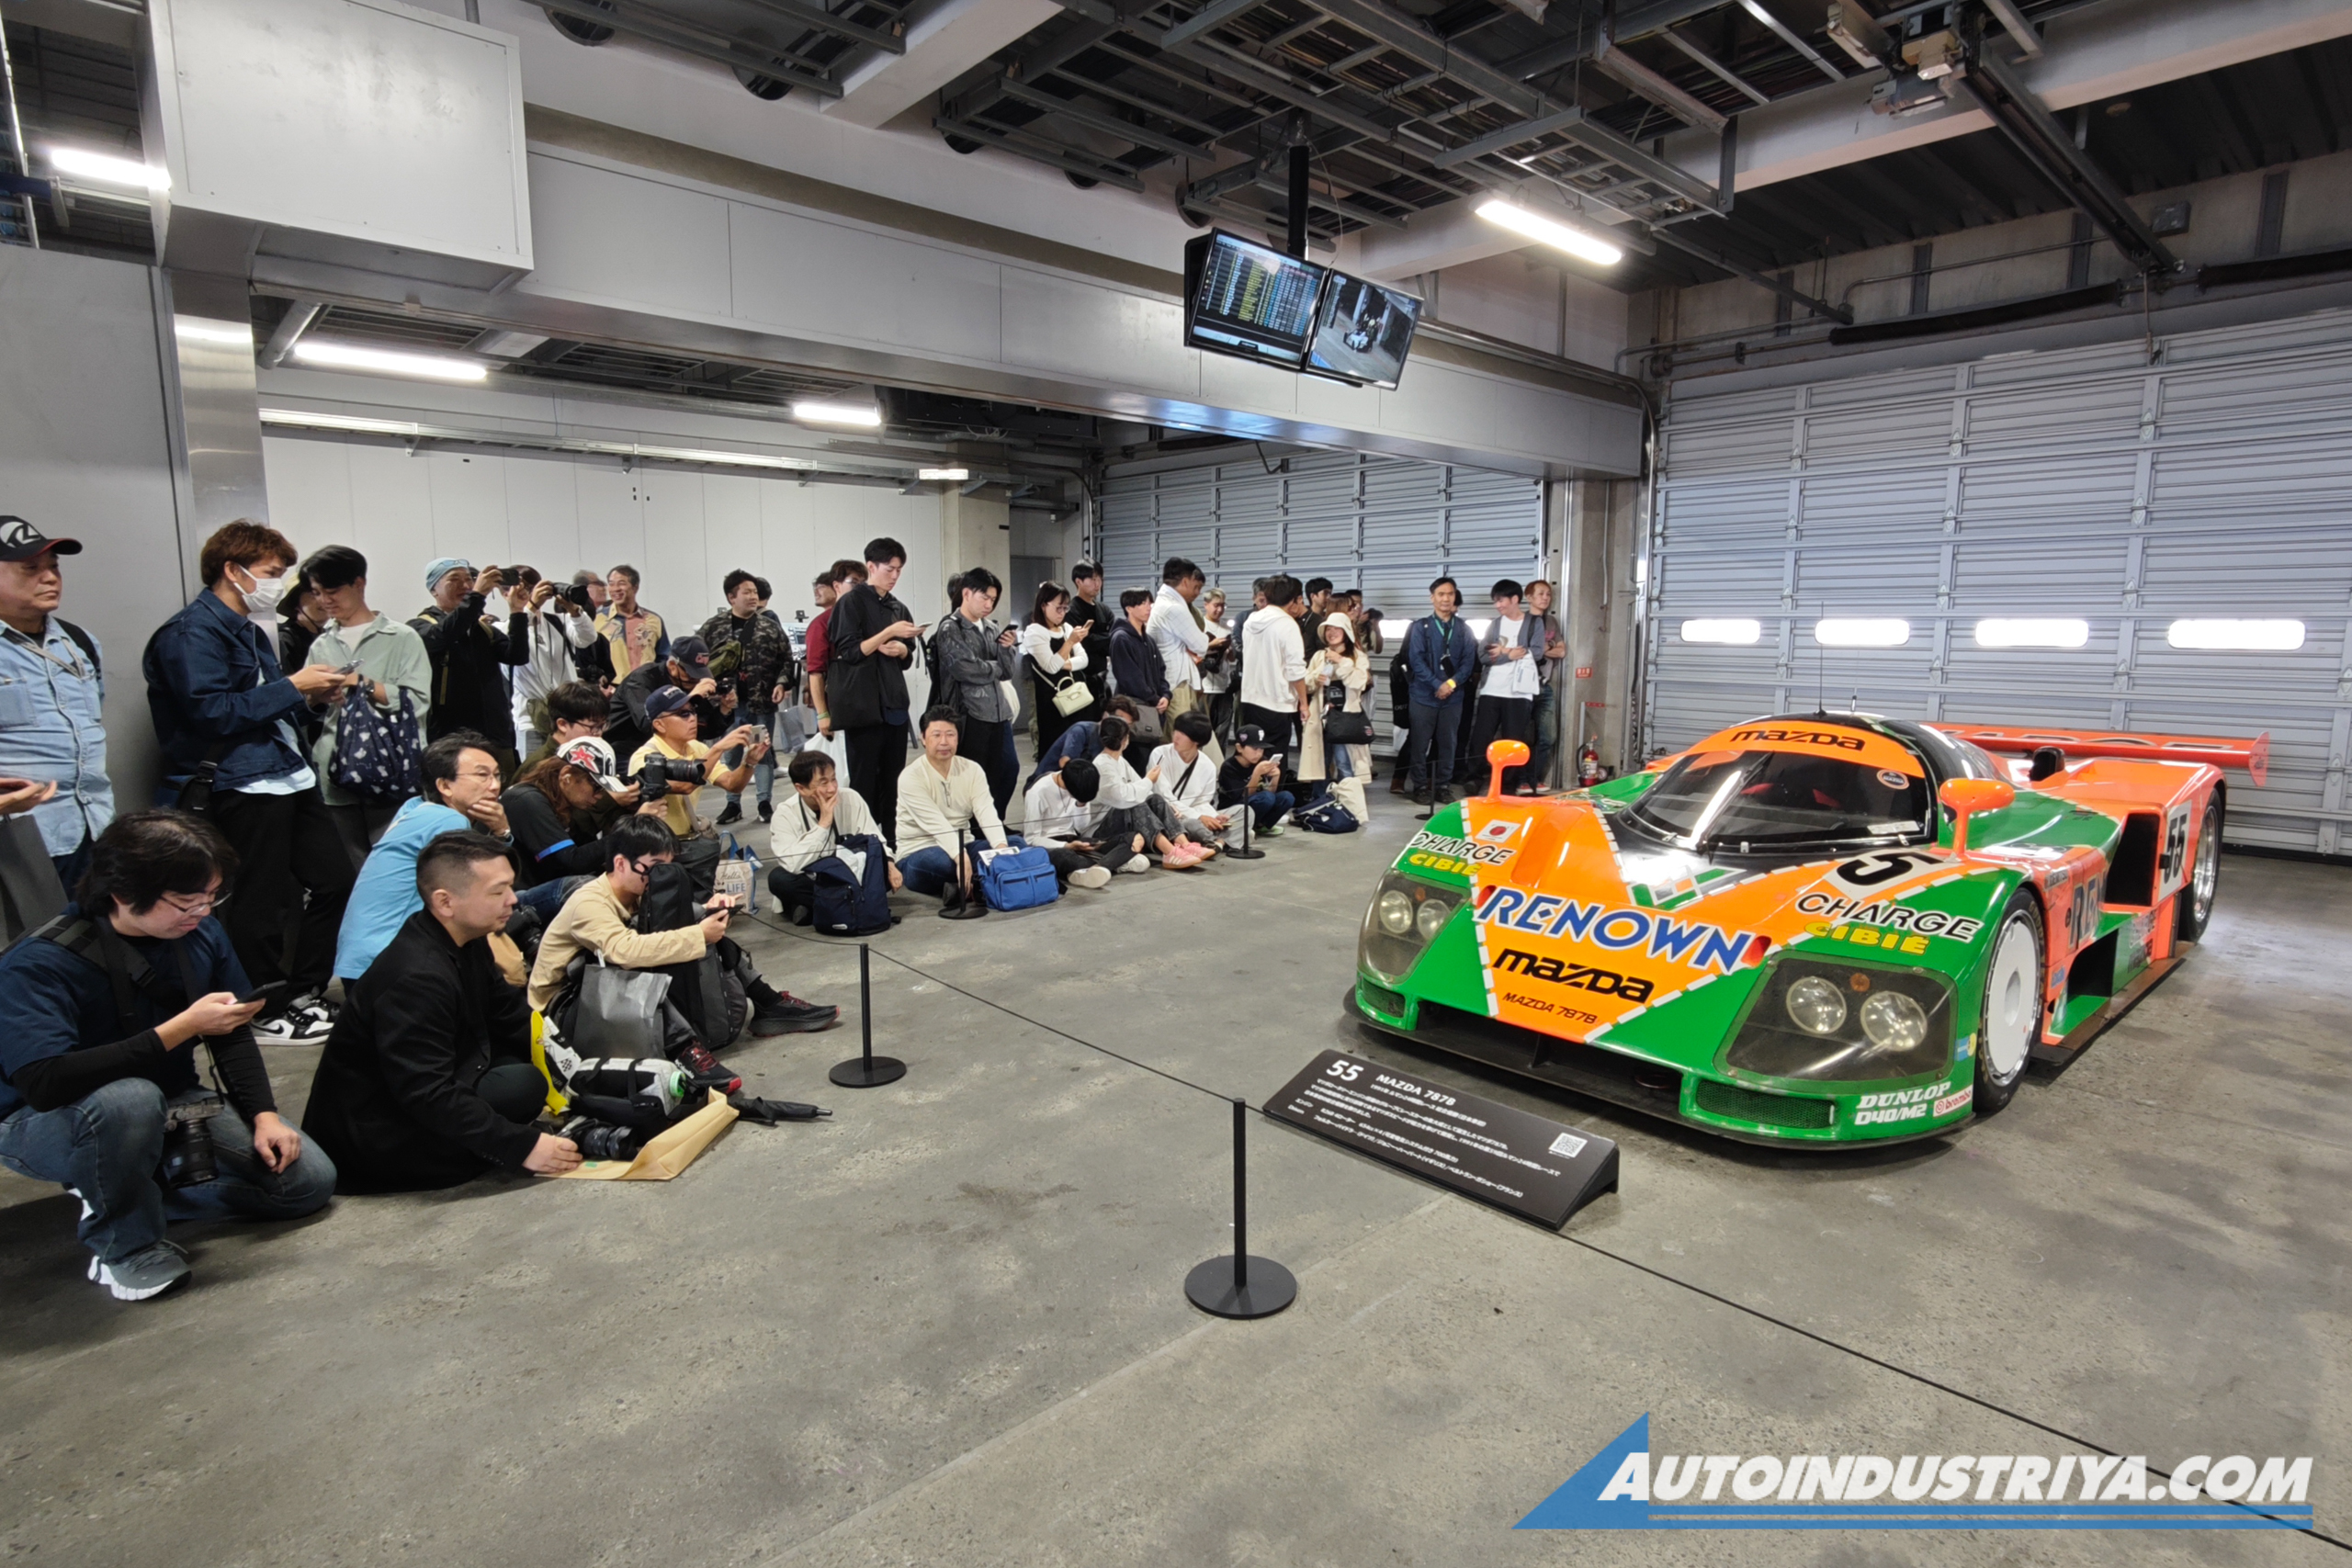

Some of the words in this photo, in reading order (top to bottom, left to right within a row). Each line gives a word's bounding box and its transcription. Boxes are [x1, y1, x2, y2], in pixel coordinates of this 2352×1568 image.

[1729, 730, 1866, 751] mazda
[1410, 831, 1516, 865] CHARGE
[2164, 813, 2188, 885] 55
[727, 883, 746, 893] LIFE
[1473, 887, 1755, 975] RENOWN
[1796, 893, 1983, 942] CHARGE
[1492, 948, 1655, 1004] mazda
[1503, 992, 1555, 1013] MAZDA
[1556, 1007, 1598, 1024] 787B
[1326, 1059, 1363, 1081] 55
[1375, 1074, 1422, 1095] MAZDA
[1423, 1089, 1456, 1106] 787B
[1856, 1081, 1951, 1109] DUNLOP
[1854, 1103, 1928, 1125] D40/M2
